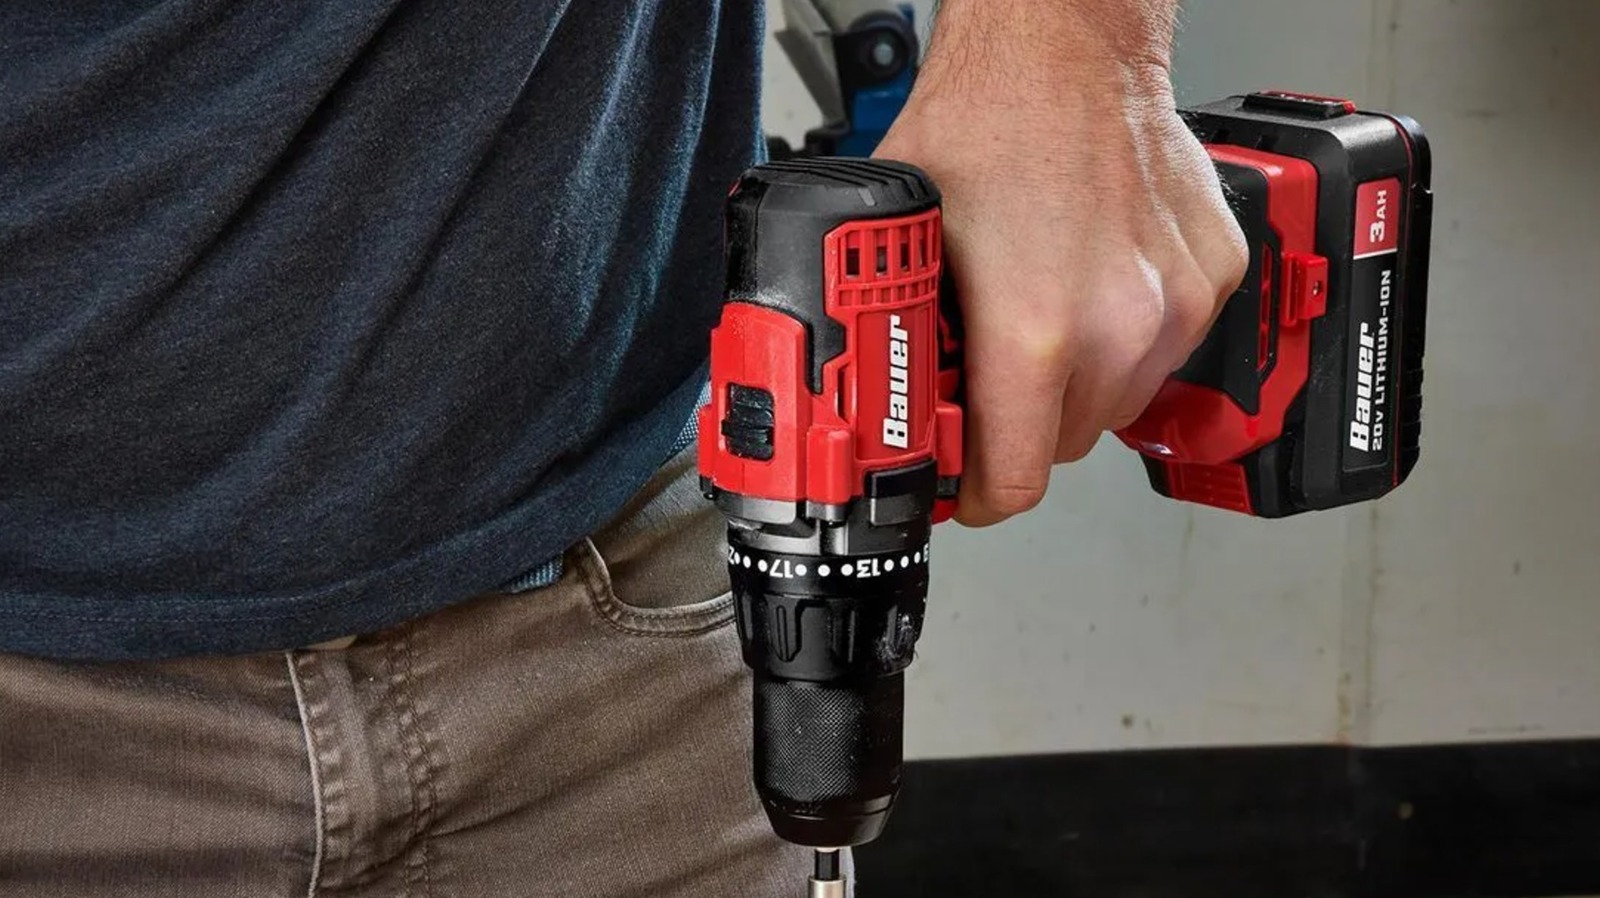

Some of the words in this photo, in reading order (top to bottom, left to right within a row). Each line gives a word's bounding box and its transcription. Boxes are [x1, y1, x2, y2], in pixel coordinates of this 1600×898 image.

[883, 314, 908, 449] Bauer
[1350, 322, 1375, 452] Bauer
[1375, 270, 1391, 404] LITHIUM-ION
[769, 559, 794, 579] 17
[857, 558, 881, 578] 13
